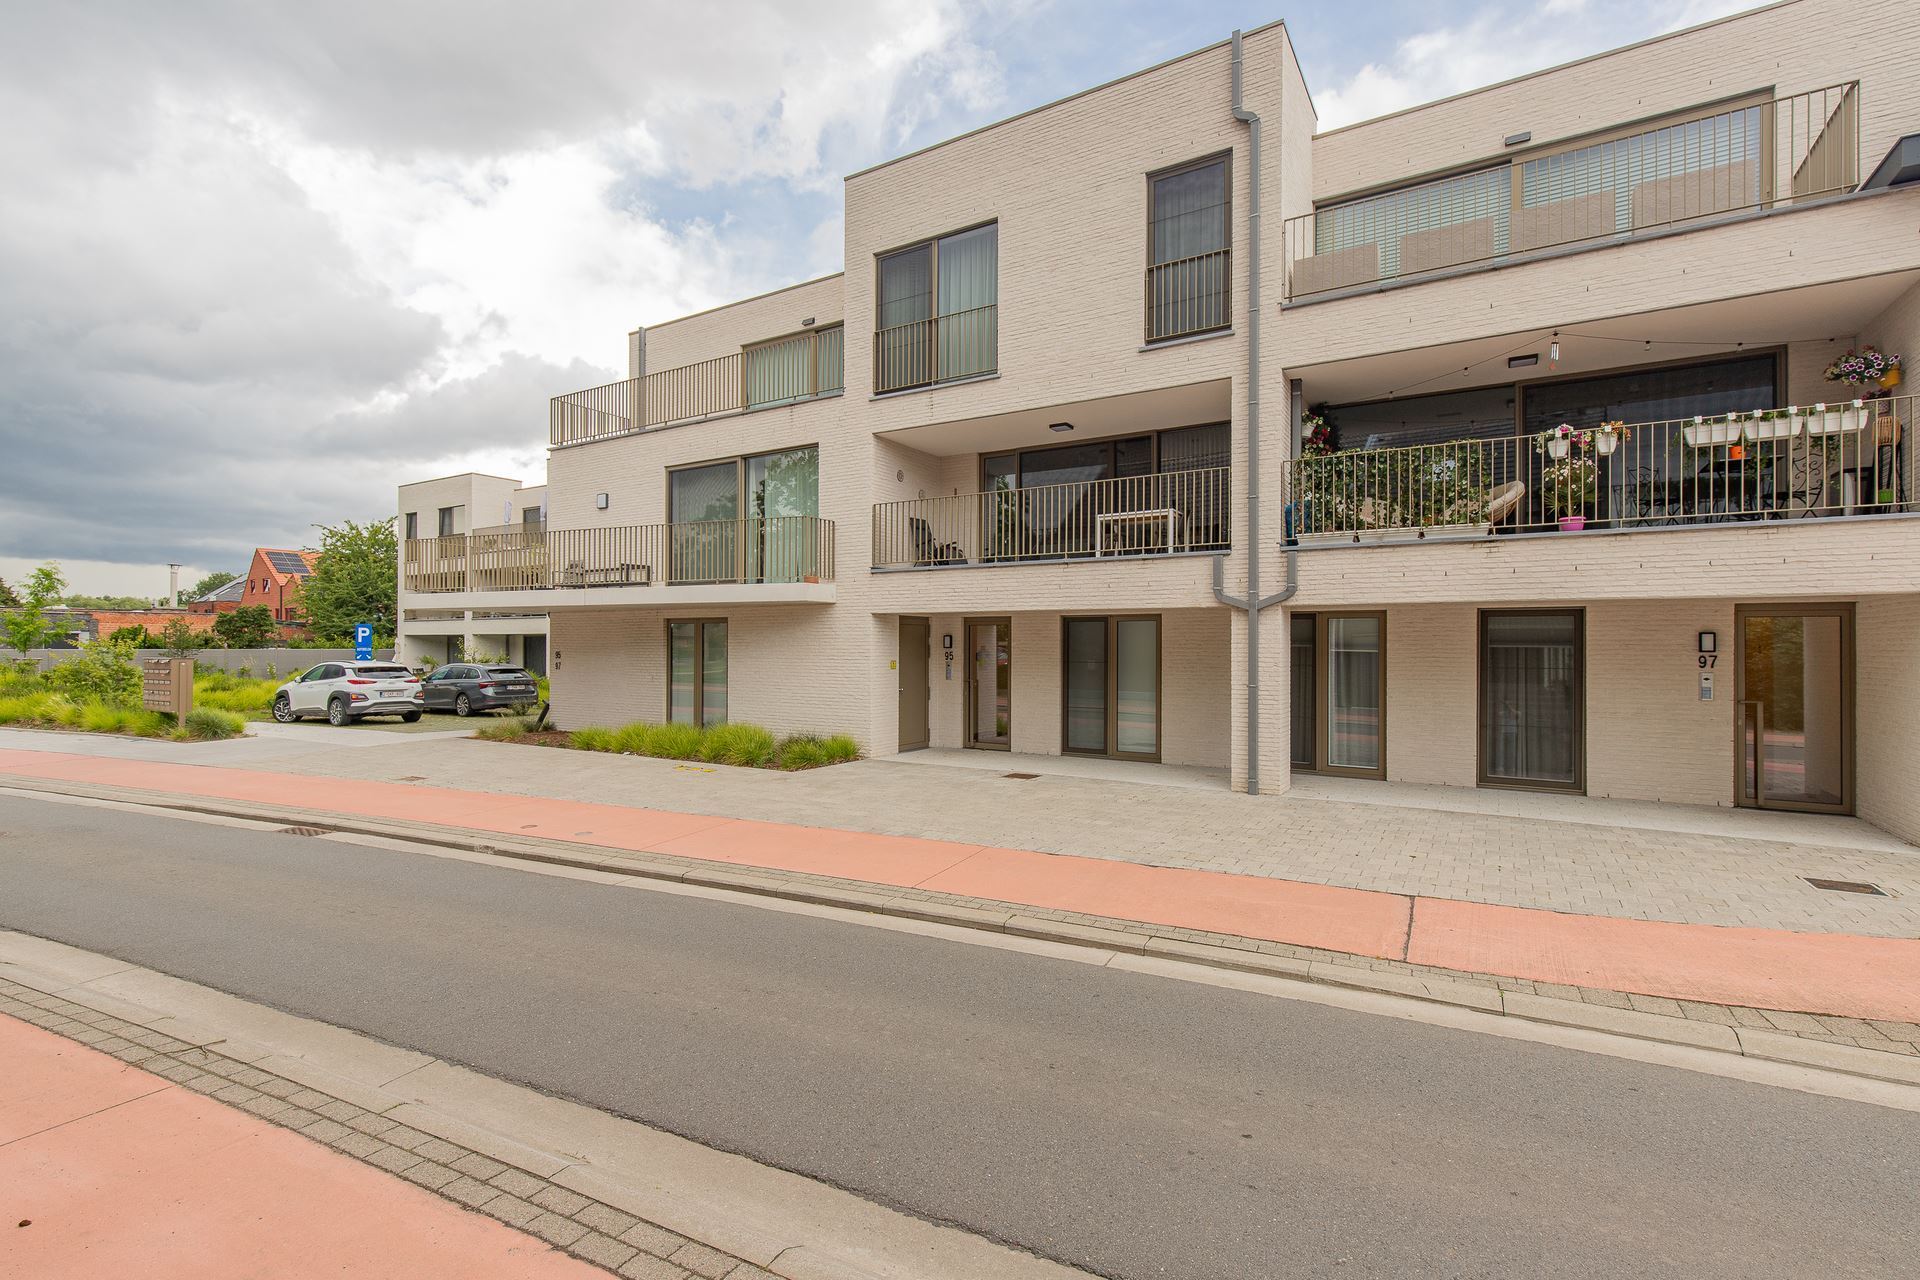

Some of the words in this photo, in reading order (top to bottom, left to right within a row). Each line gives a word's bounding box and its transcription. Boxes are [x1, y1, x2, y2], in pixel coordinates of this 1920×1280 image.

[358, 627, 370, 643] P
[555, 651, 561, 659] 95
[945, 652, 954, 661] 95
[1698, 655, 1718, 669] 97
